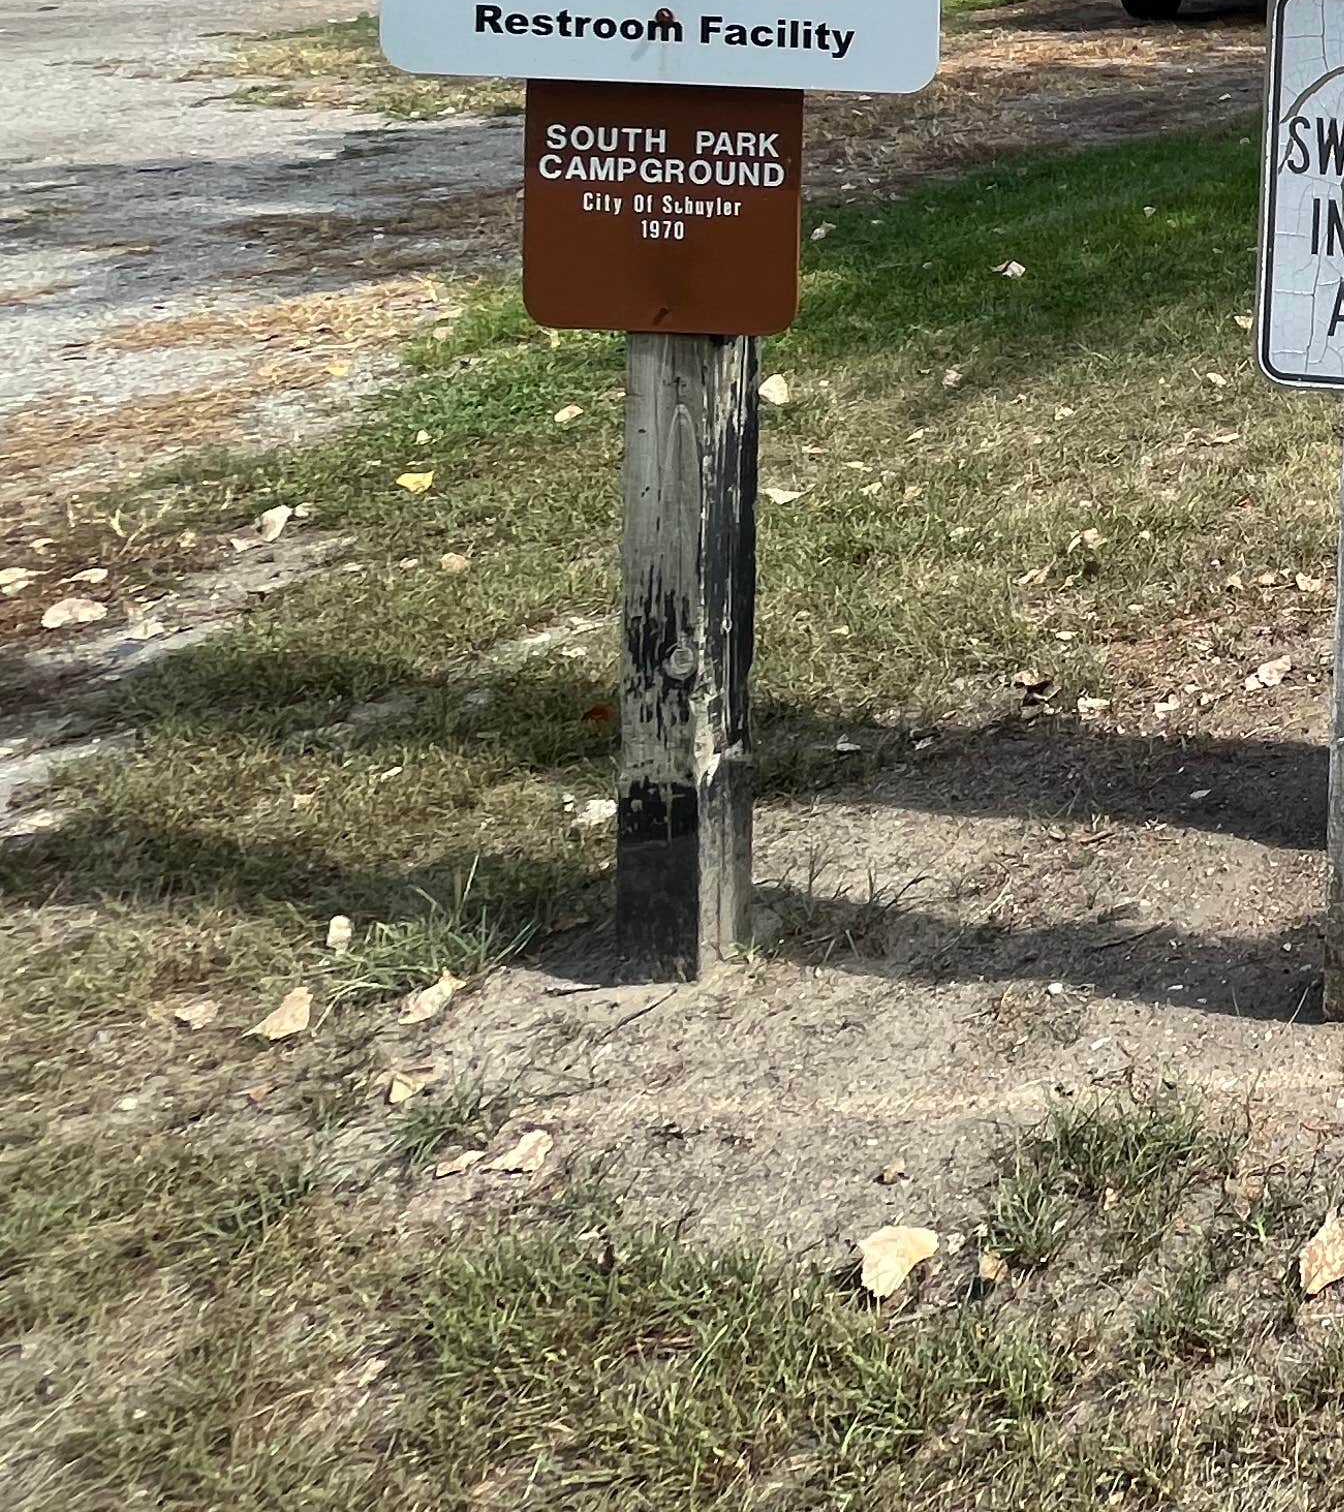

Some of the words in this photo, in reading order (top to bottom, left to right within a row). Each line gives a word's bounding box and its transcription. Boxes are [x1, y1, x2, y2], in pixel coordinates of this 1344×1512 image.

[476, 5, 682, 42] Restroom
[701, 16, 854, 58] Facility
[547, 125, 665, 153] SOUTH
[696, 131, 779, 157] PARK
[540, 155, 784, 186] CAMPGROUND
[584, 193, 621, 215] City
[634, 195, 652, 212] Of
[663, 195, 741, 217] Schuyler
[641, 220, 683, 239] 1970
